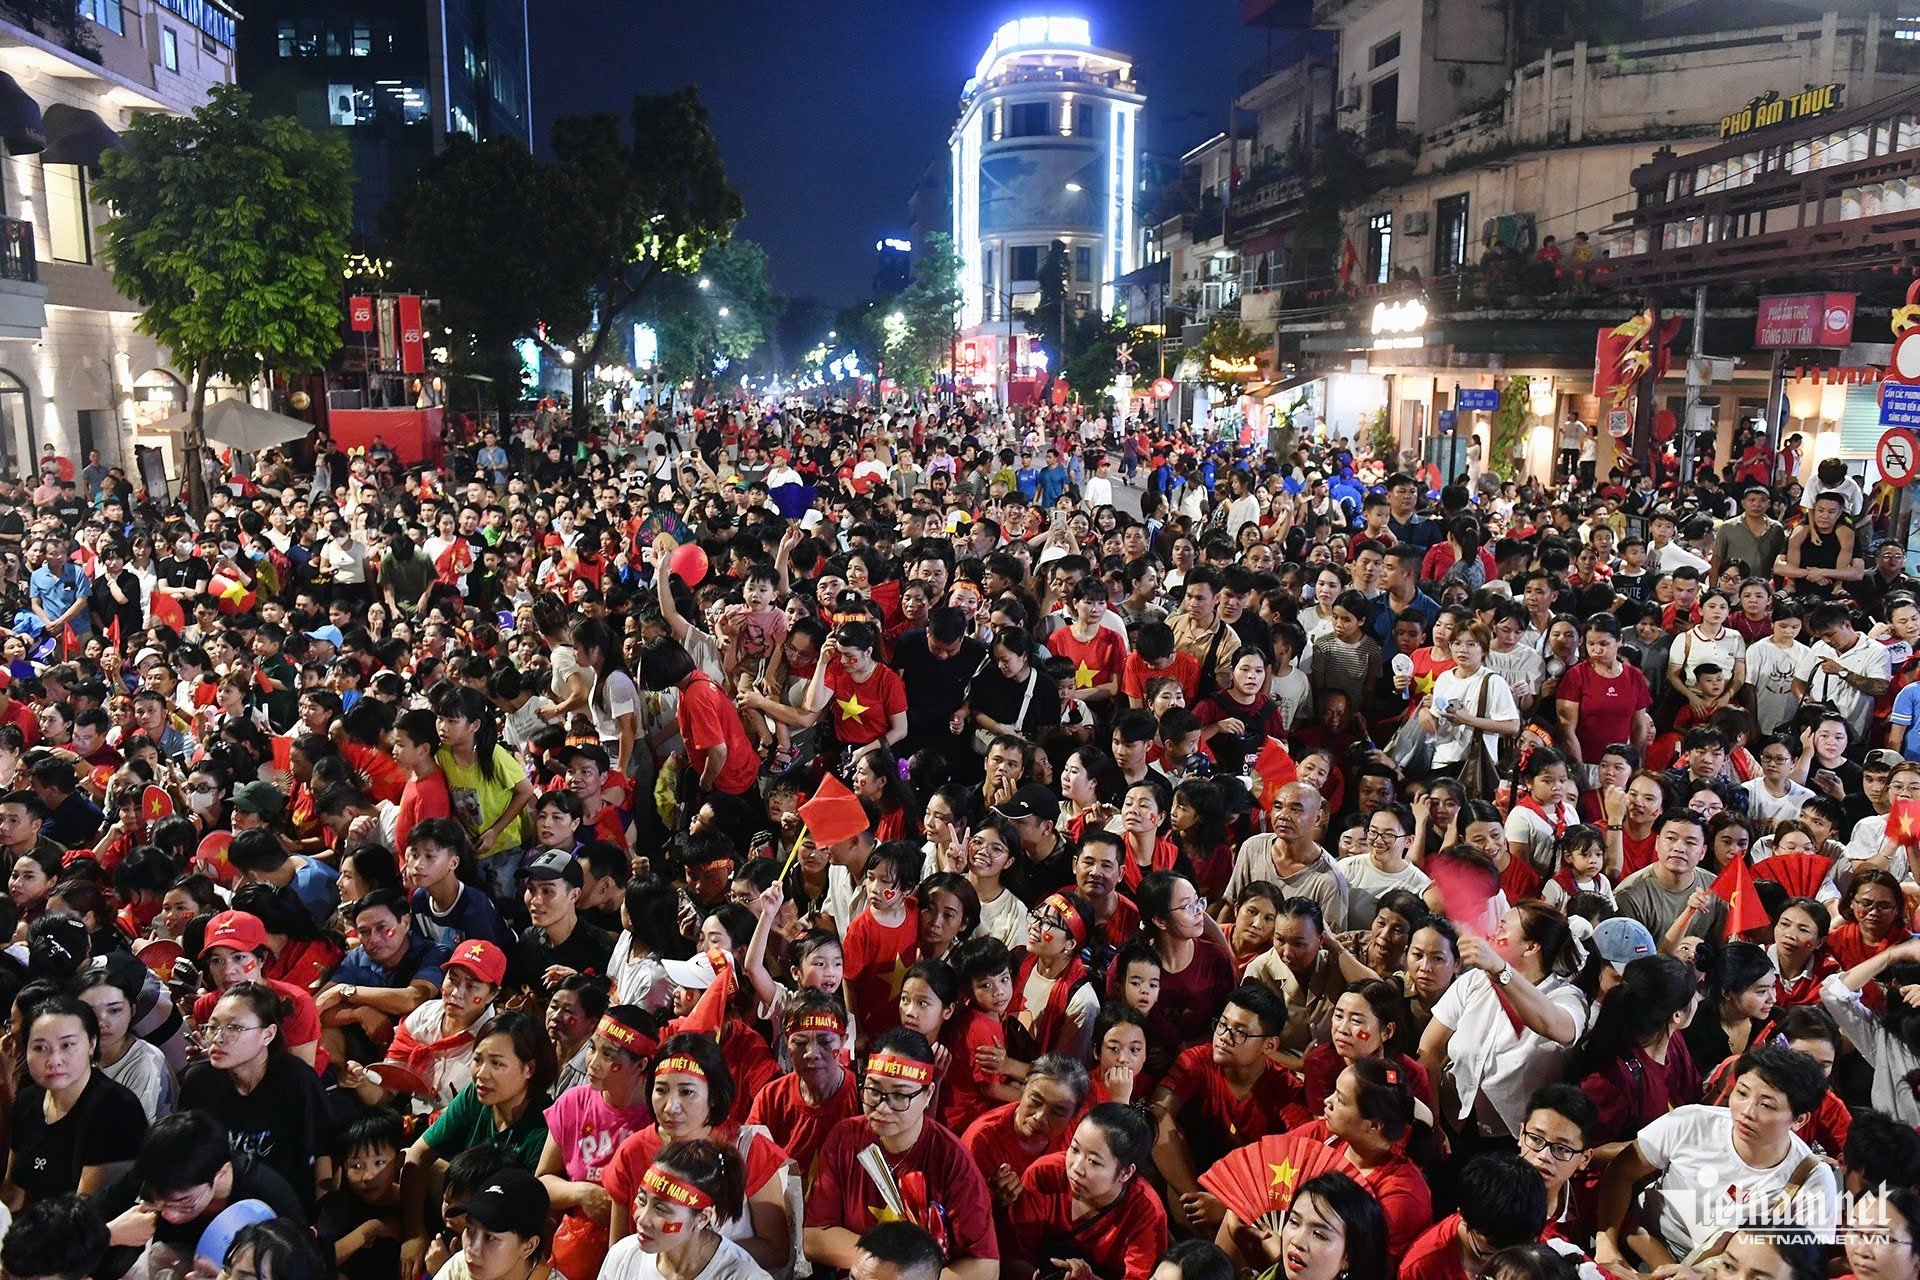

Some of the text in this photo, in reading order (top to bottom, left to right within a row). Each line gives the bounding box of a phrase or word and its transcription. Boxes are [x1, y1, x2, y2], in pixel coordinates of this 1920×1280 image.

[1720, 84, 1837, 138] PHỐ ẨM THỰC
[671, 1056, 689, 1071] VIỆT
[884, 1060, 902, 1076] VIỆT
[901, 1064, 920, 1079] NAM
[667, 1183, 689, 1203] NAM
